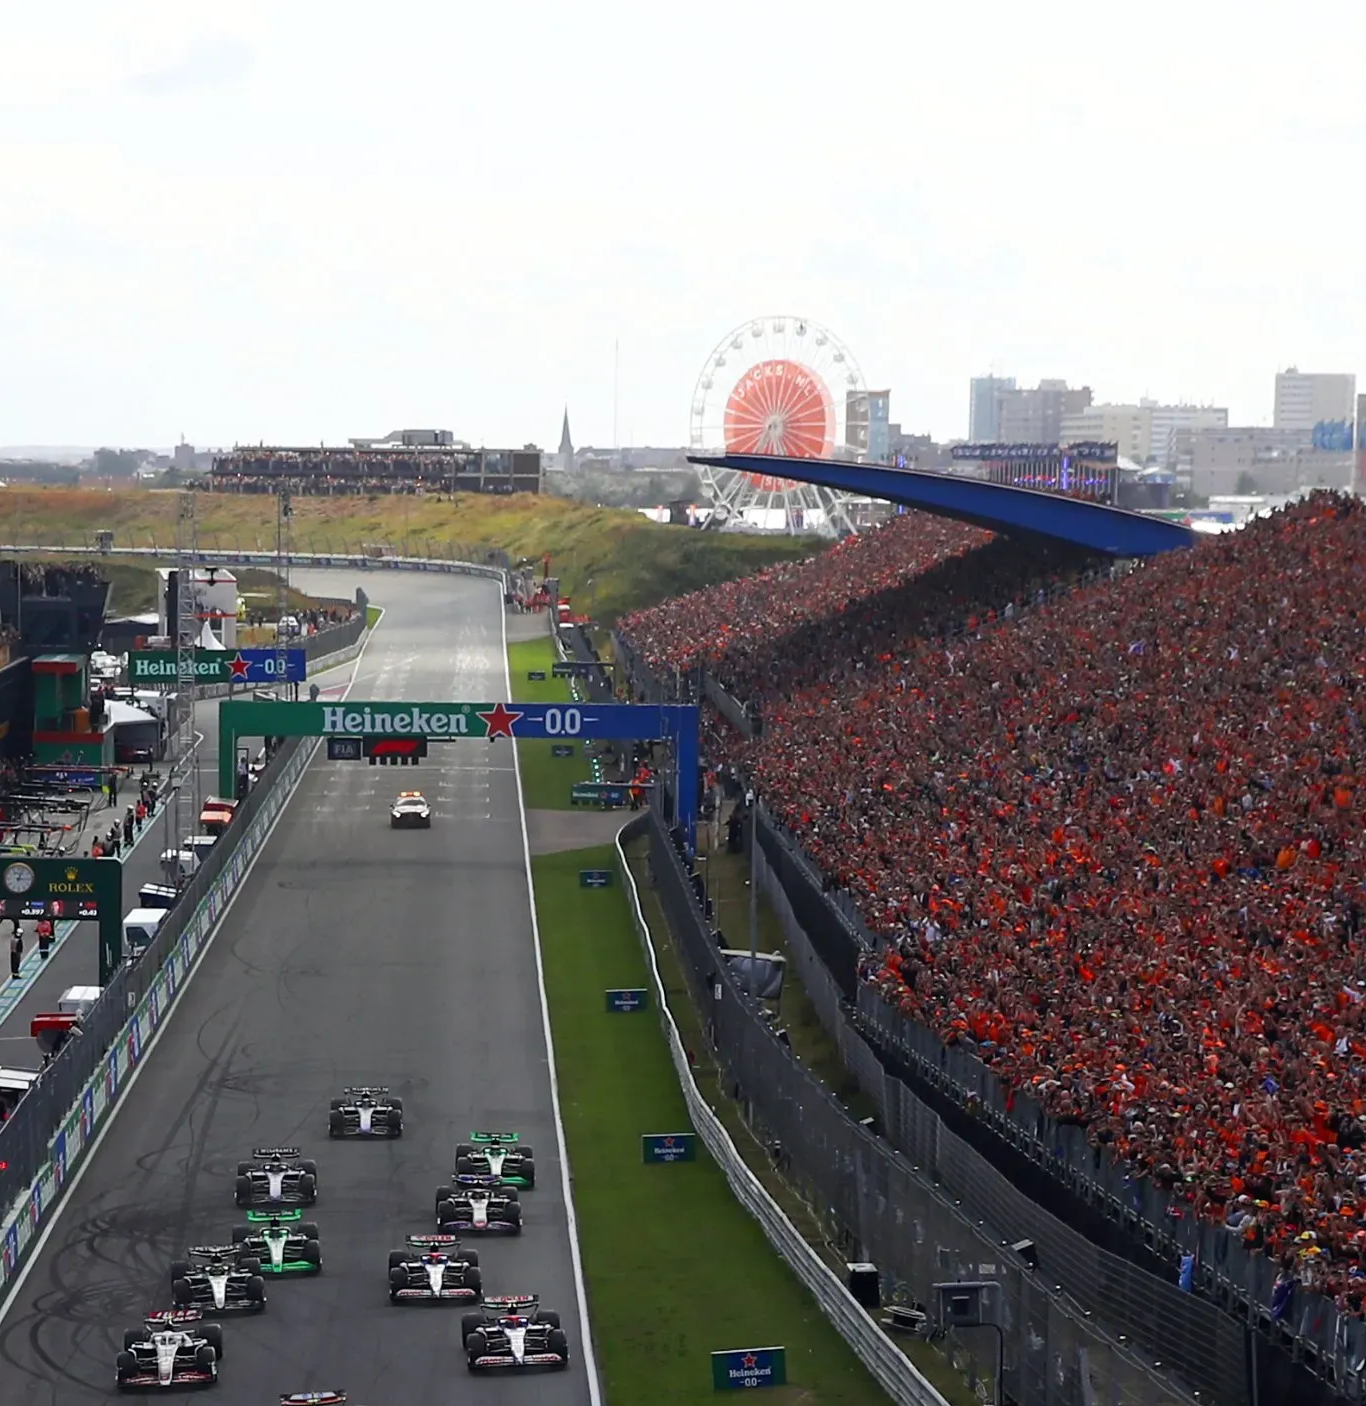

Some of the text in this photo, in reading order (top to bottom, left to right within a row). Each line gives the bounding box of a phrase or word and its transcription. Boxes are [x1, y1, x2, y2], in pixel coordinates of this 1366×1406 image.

[135, 659, 221, 675] Heineken
[322, 706, 581, 734] Heineken 0.0
[335, 744, 353, 755] FIA
[49, 883, 94, 893] ROLEX
[729, 1367, 771, 1378] Heineken
